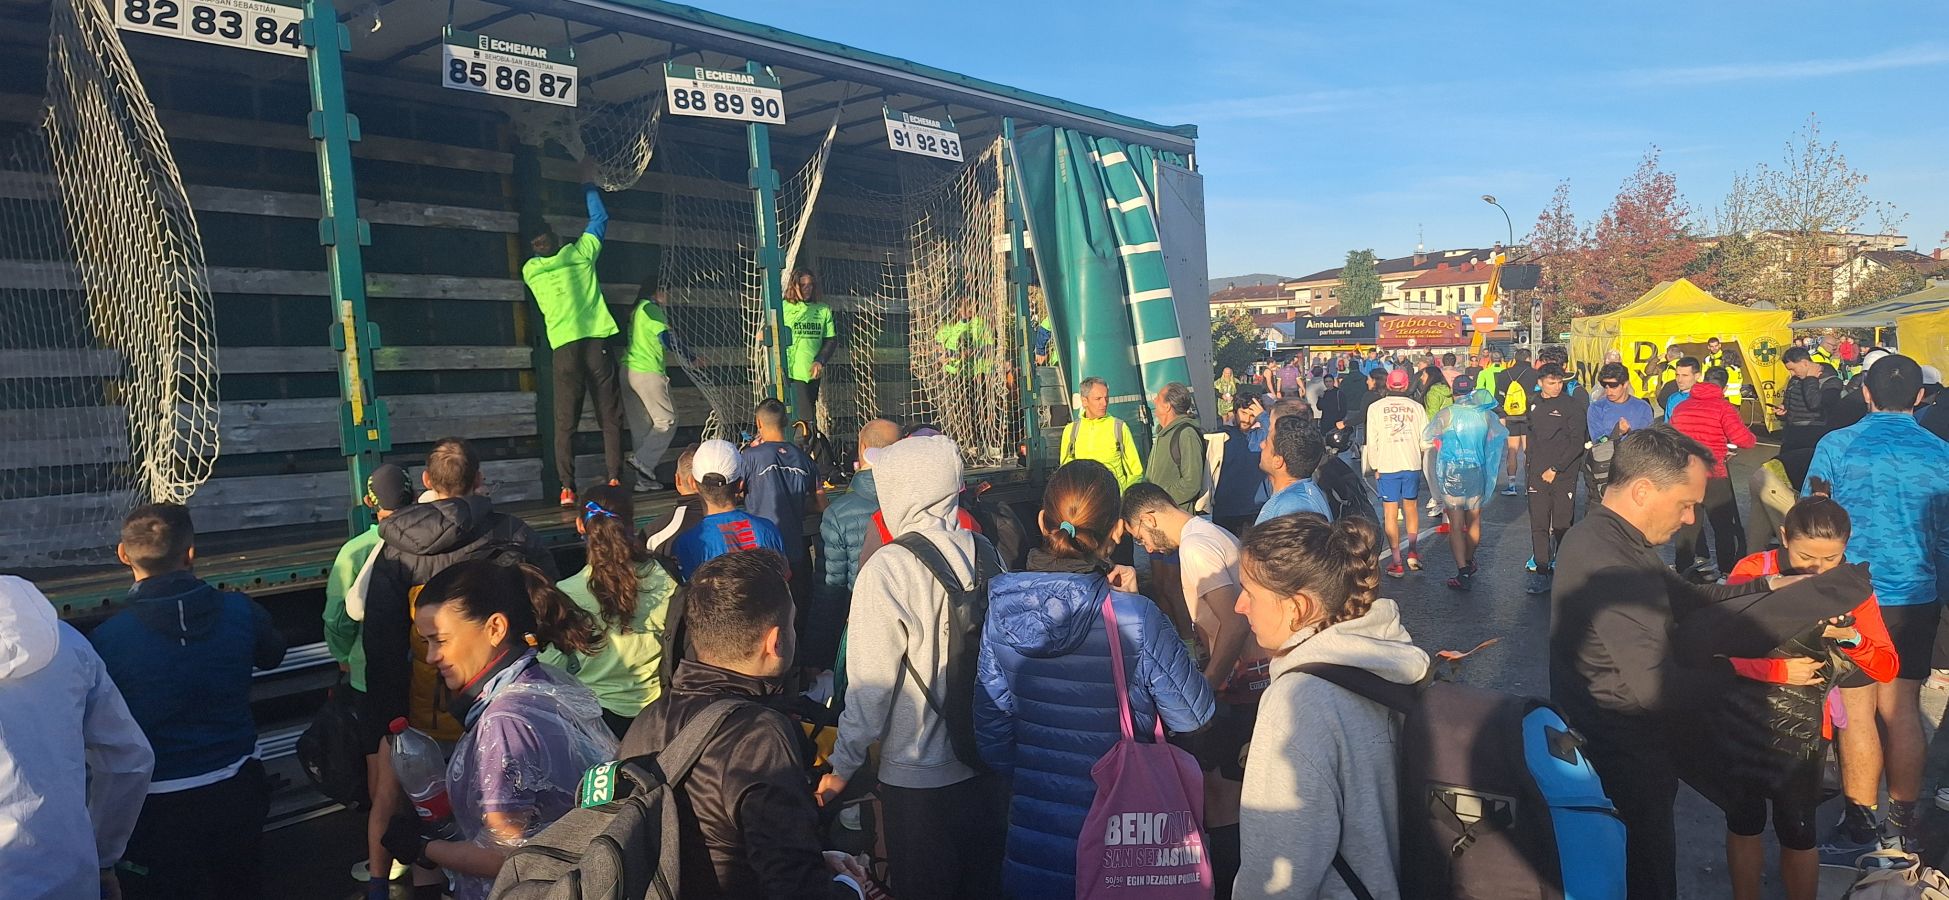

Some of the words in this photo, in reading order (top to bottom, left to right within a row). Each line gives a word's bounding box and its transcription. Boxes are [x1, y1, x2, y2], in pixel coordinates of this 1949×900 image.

[124, 0, 179, 30] 82
[191, 6, 243, 39] 83
[254, 17, 301, 49] 84
[490, 39, 547, 59] ECHEMAR
[449, 58, 487, 87] 85
[495, 66, 531, 93] 86
[539, 73, 572, 99] 87
[705, 70, 755, 85] ECHEMAR
[673, 88, 707, 111] 88
[713, 92, 744, 115] 89
[751, 96, 780, 119] 90
[909, 115, 942, 128] ECHEMAR
[893, 129, 912, 148] 91
[916, 133, 938, 152] 92
[940, 138, 960, 157] 93
[1383, 316, 1456, 331] Tabacos
[1390, 414, 1414, 422] RUN
[1103, 848, 1133, 869] SAN
